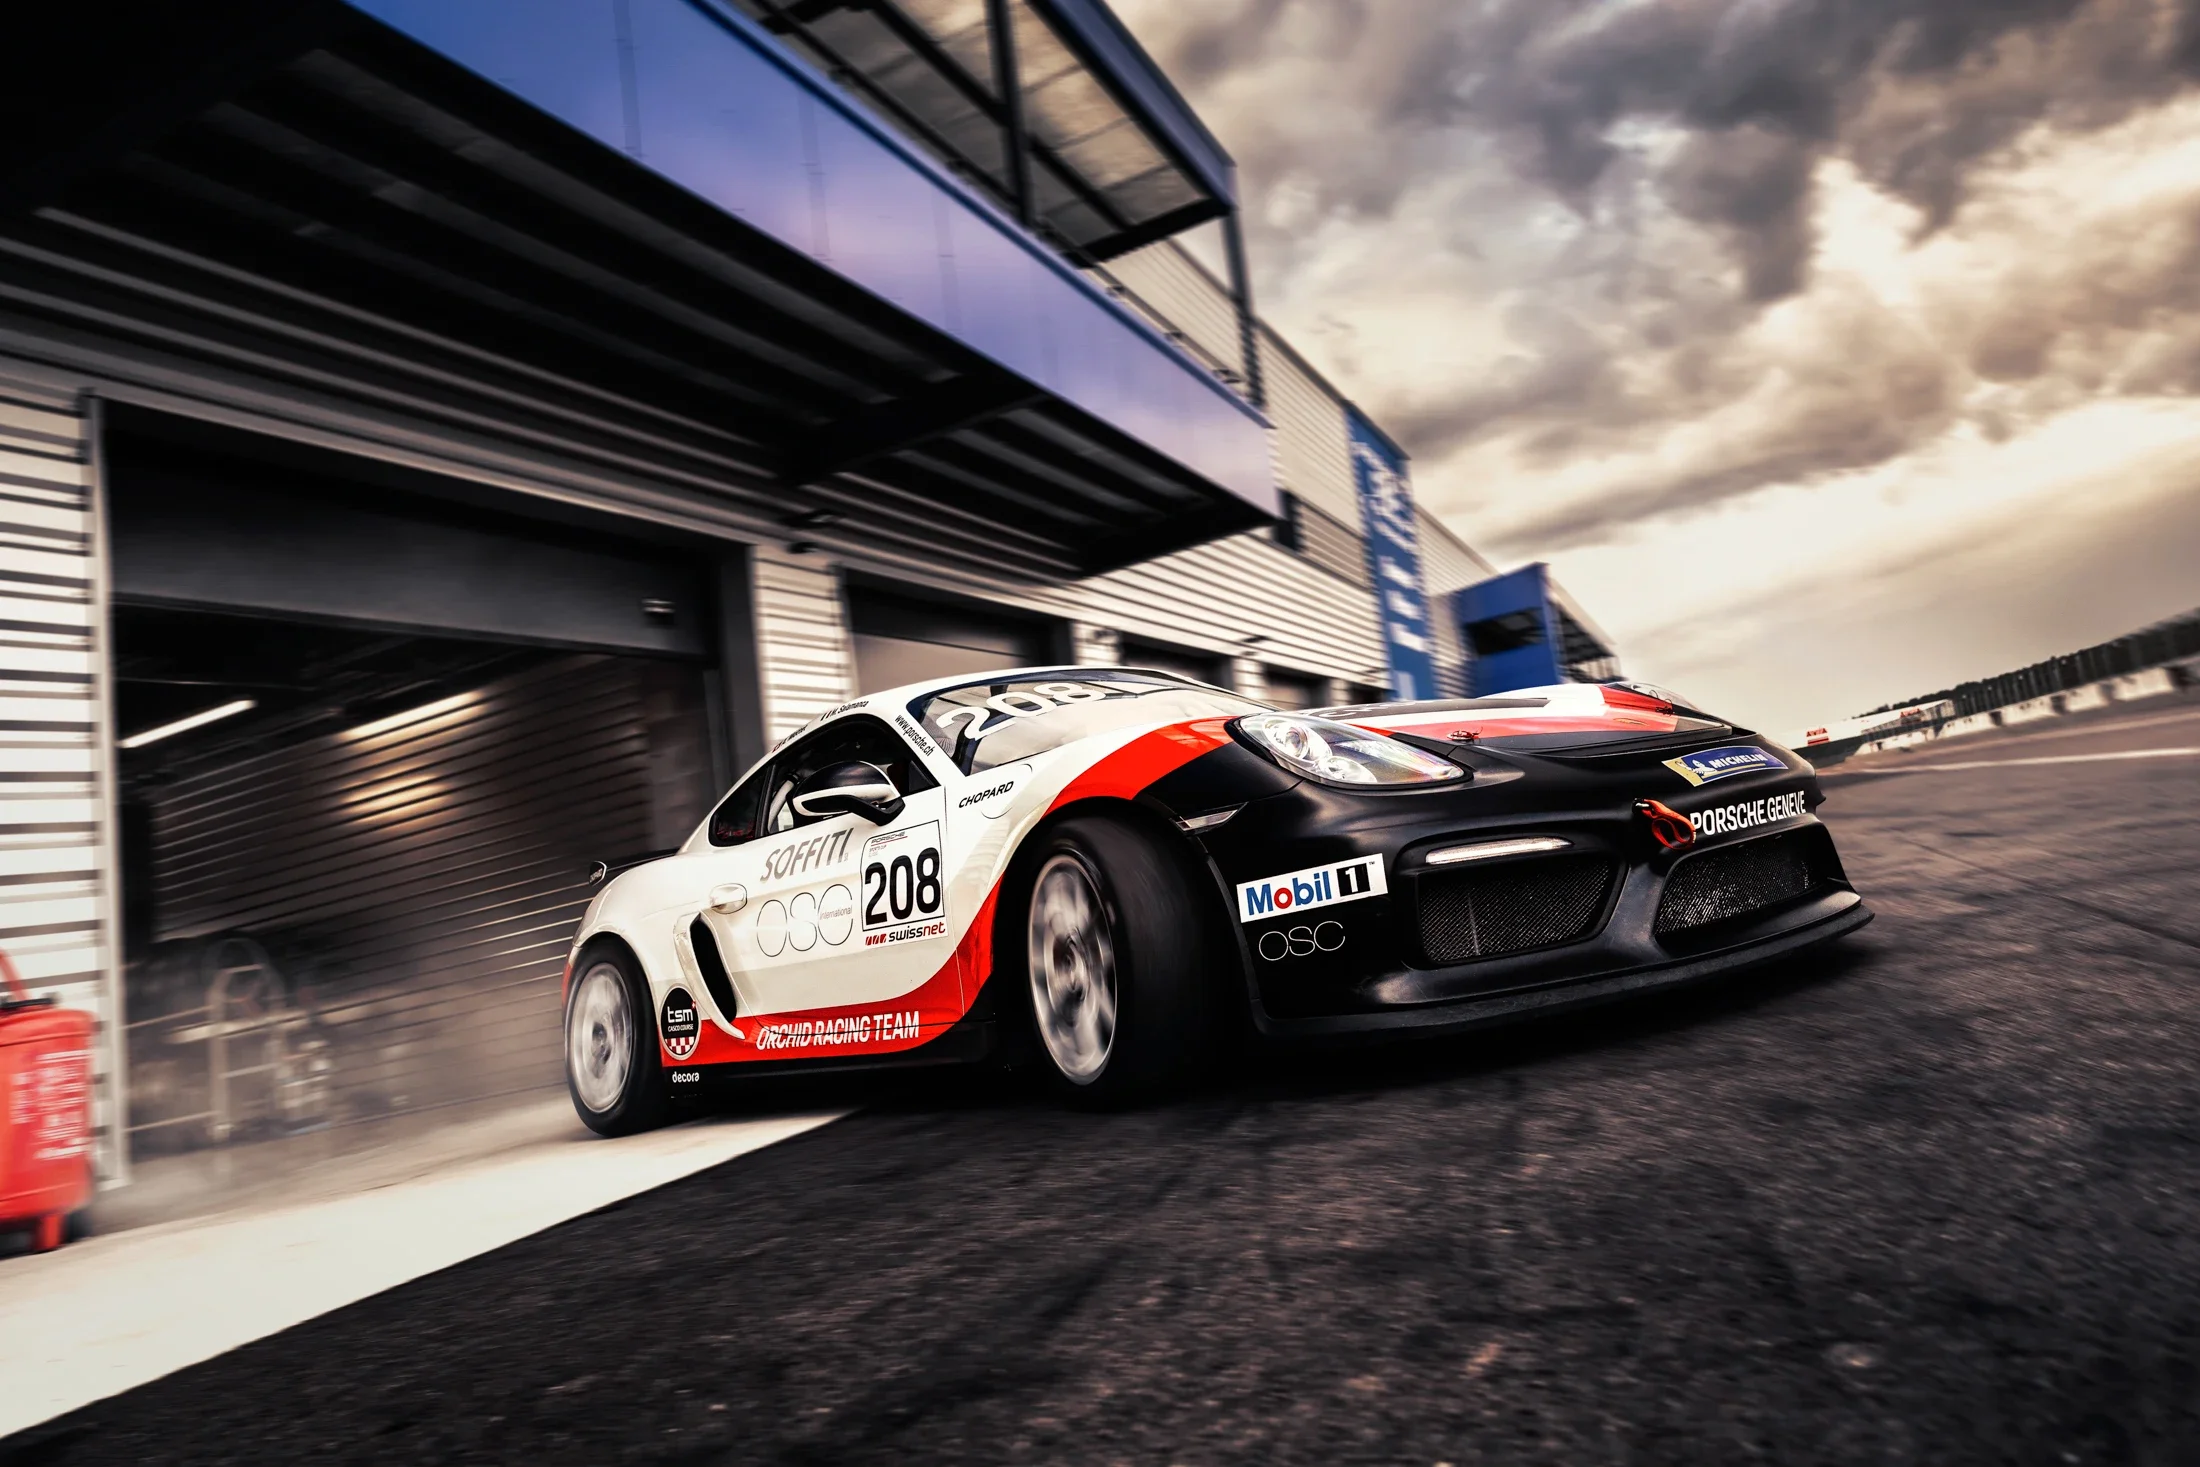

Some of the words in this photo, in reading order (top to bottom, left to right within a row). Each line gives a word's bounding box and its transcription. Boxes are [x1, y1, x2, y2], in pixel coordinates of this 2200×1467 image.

[936, 682, 1106, 741] 208
[894, 714, 935, 757] www.porsche.ch
[1708, 752, 1769, 769] MICHELIN
[958, 780, 1015, 809] CHOPARD
[1689, 798, 1767, 836] PORSCHE
[1766, 790, 1807, 822] GENEVE
[760, 827, 855, 881] SOFFITI
[864, 846, 941, 926] 208
[1245, 871, 1332, 916] Mobil
[888, 921, 946, 942] swissnet
[1258, 920, 1346, 961] OSC
[667, 1006, 694, 1023] tsm
[756, 1022, 812, 1050] ORCHID
[813, 1015, 871, 1046] RACING
[869, 1010, 919, 1041] TEAM
[672, 1071, 700, 1083] decora
